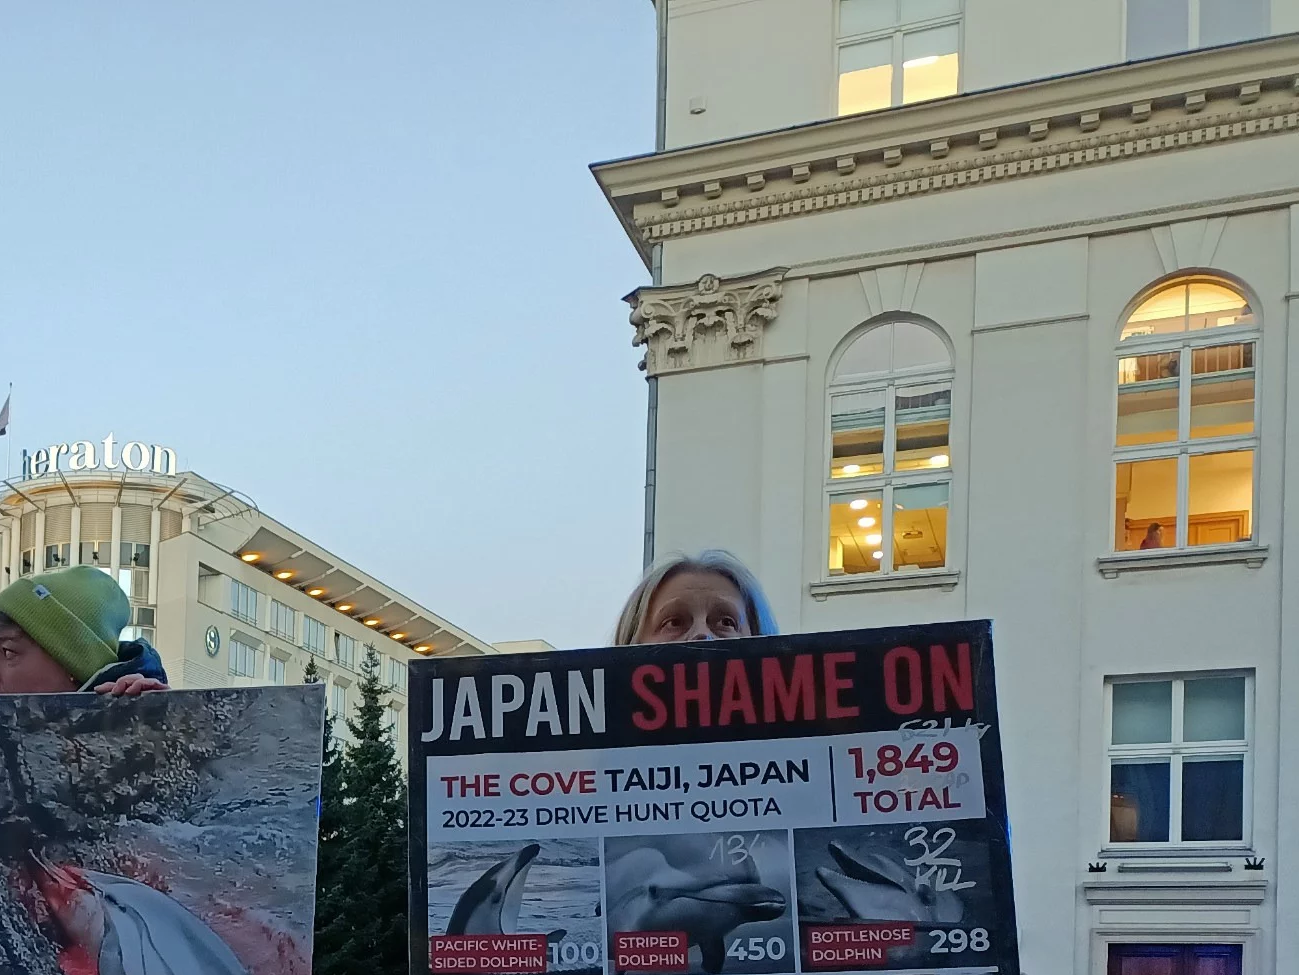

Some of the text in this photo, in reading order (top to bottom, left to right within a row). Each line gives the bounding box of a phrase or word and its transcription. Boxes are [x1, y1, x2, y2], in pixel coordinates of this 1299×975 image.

[421, 643, 975, 742] JAPAN SHAME ON
[848, 742, 959, 784] 1,849
[441, 759, 810, 798] THE COVE TAIJI, JAPAN
[853, 787, 962, 813] TOTAL
[442, 797, 782, 828] 2022-23 DRIVE HUNT QUOTA
[904, 826, 962, 867] 32
[435, 939, 543, 951] PACIFIC WHITE-
[619, 936, 680, 949] STRIPED
[811, 928, 911, 943] BOTTLENOSE
[928, 928, 990, 953] 298
[548, 942, 599, 964] 100
[618, 954, 685, 966] DOLPHIN
[727, 937, 786, 960] 450
[813, 948, 882, 961] DOLPHIN
[435, 956, 543, 969] SIDED DOLPHIN
